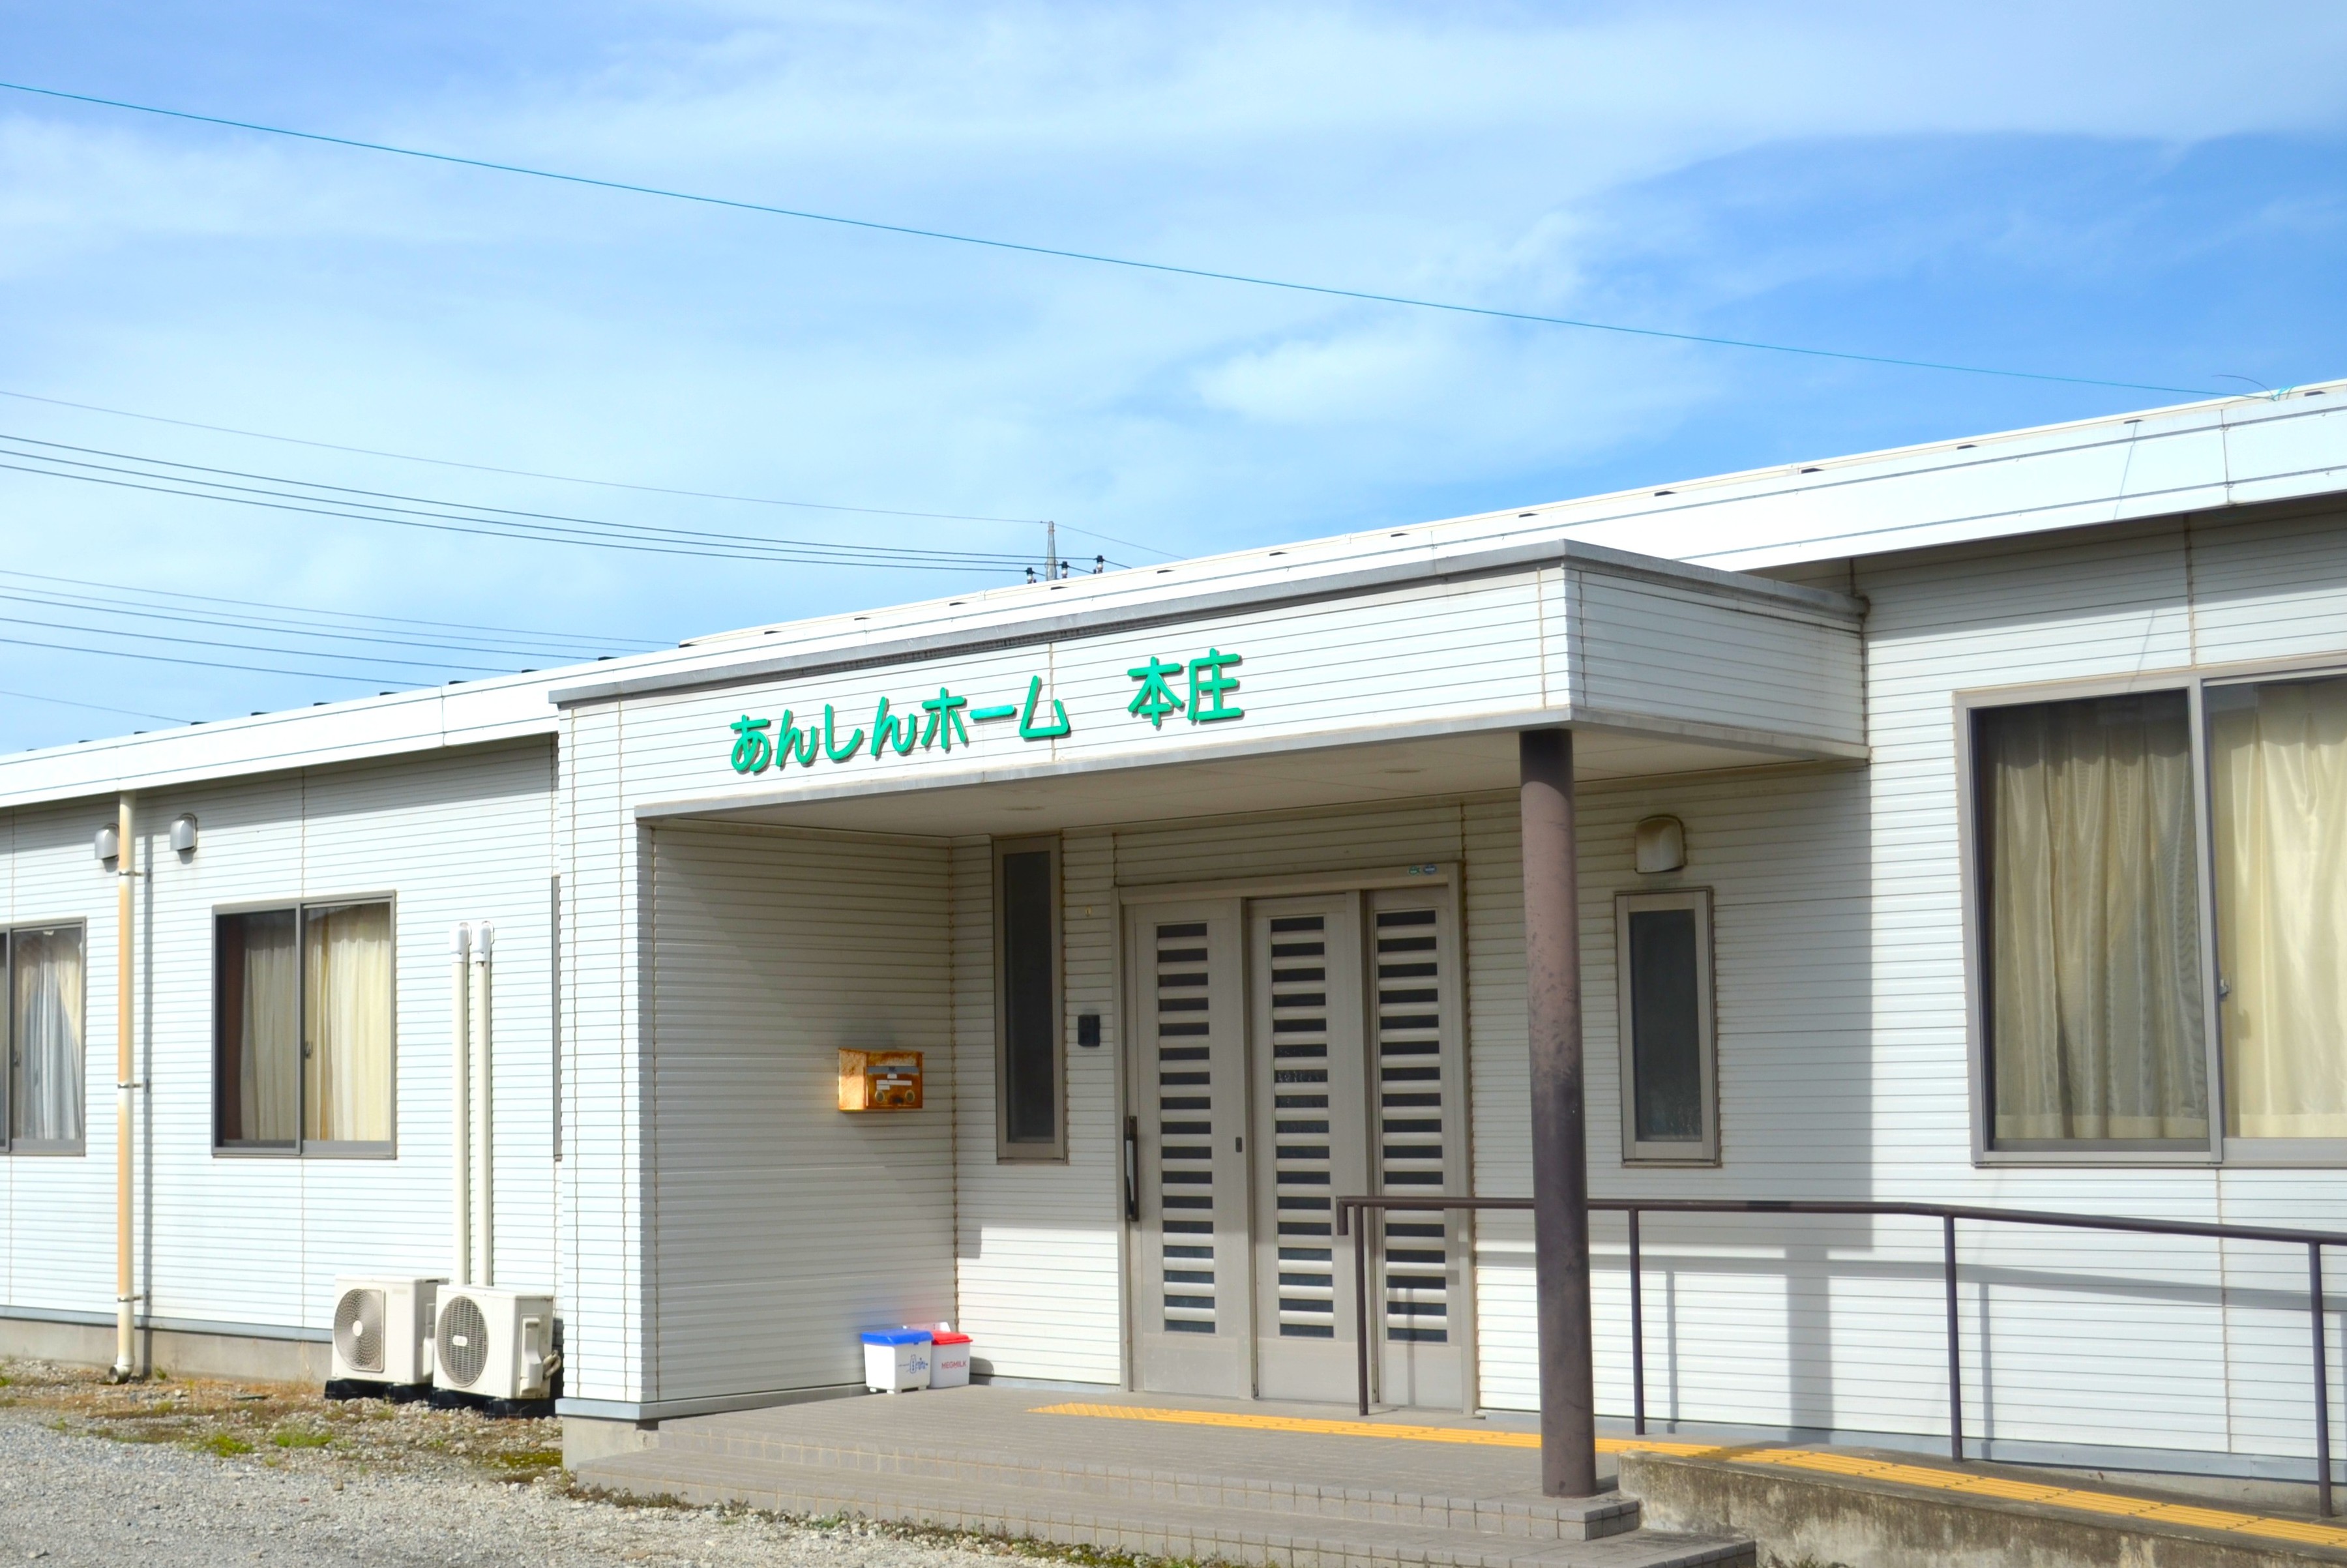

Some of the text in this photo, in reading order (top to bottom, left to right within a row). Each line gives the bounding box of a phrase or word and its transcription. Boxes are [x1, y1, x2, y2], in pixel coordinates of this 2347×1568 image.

[730, 647, 1243, 773] あんしんホーム 本庄
